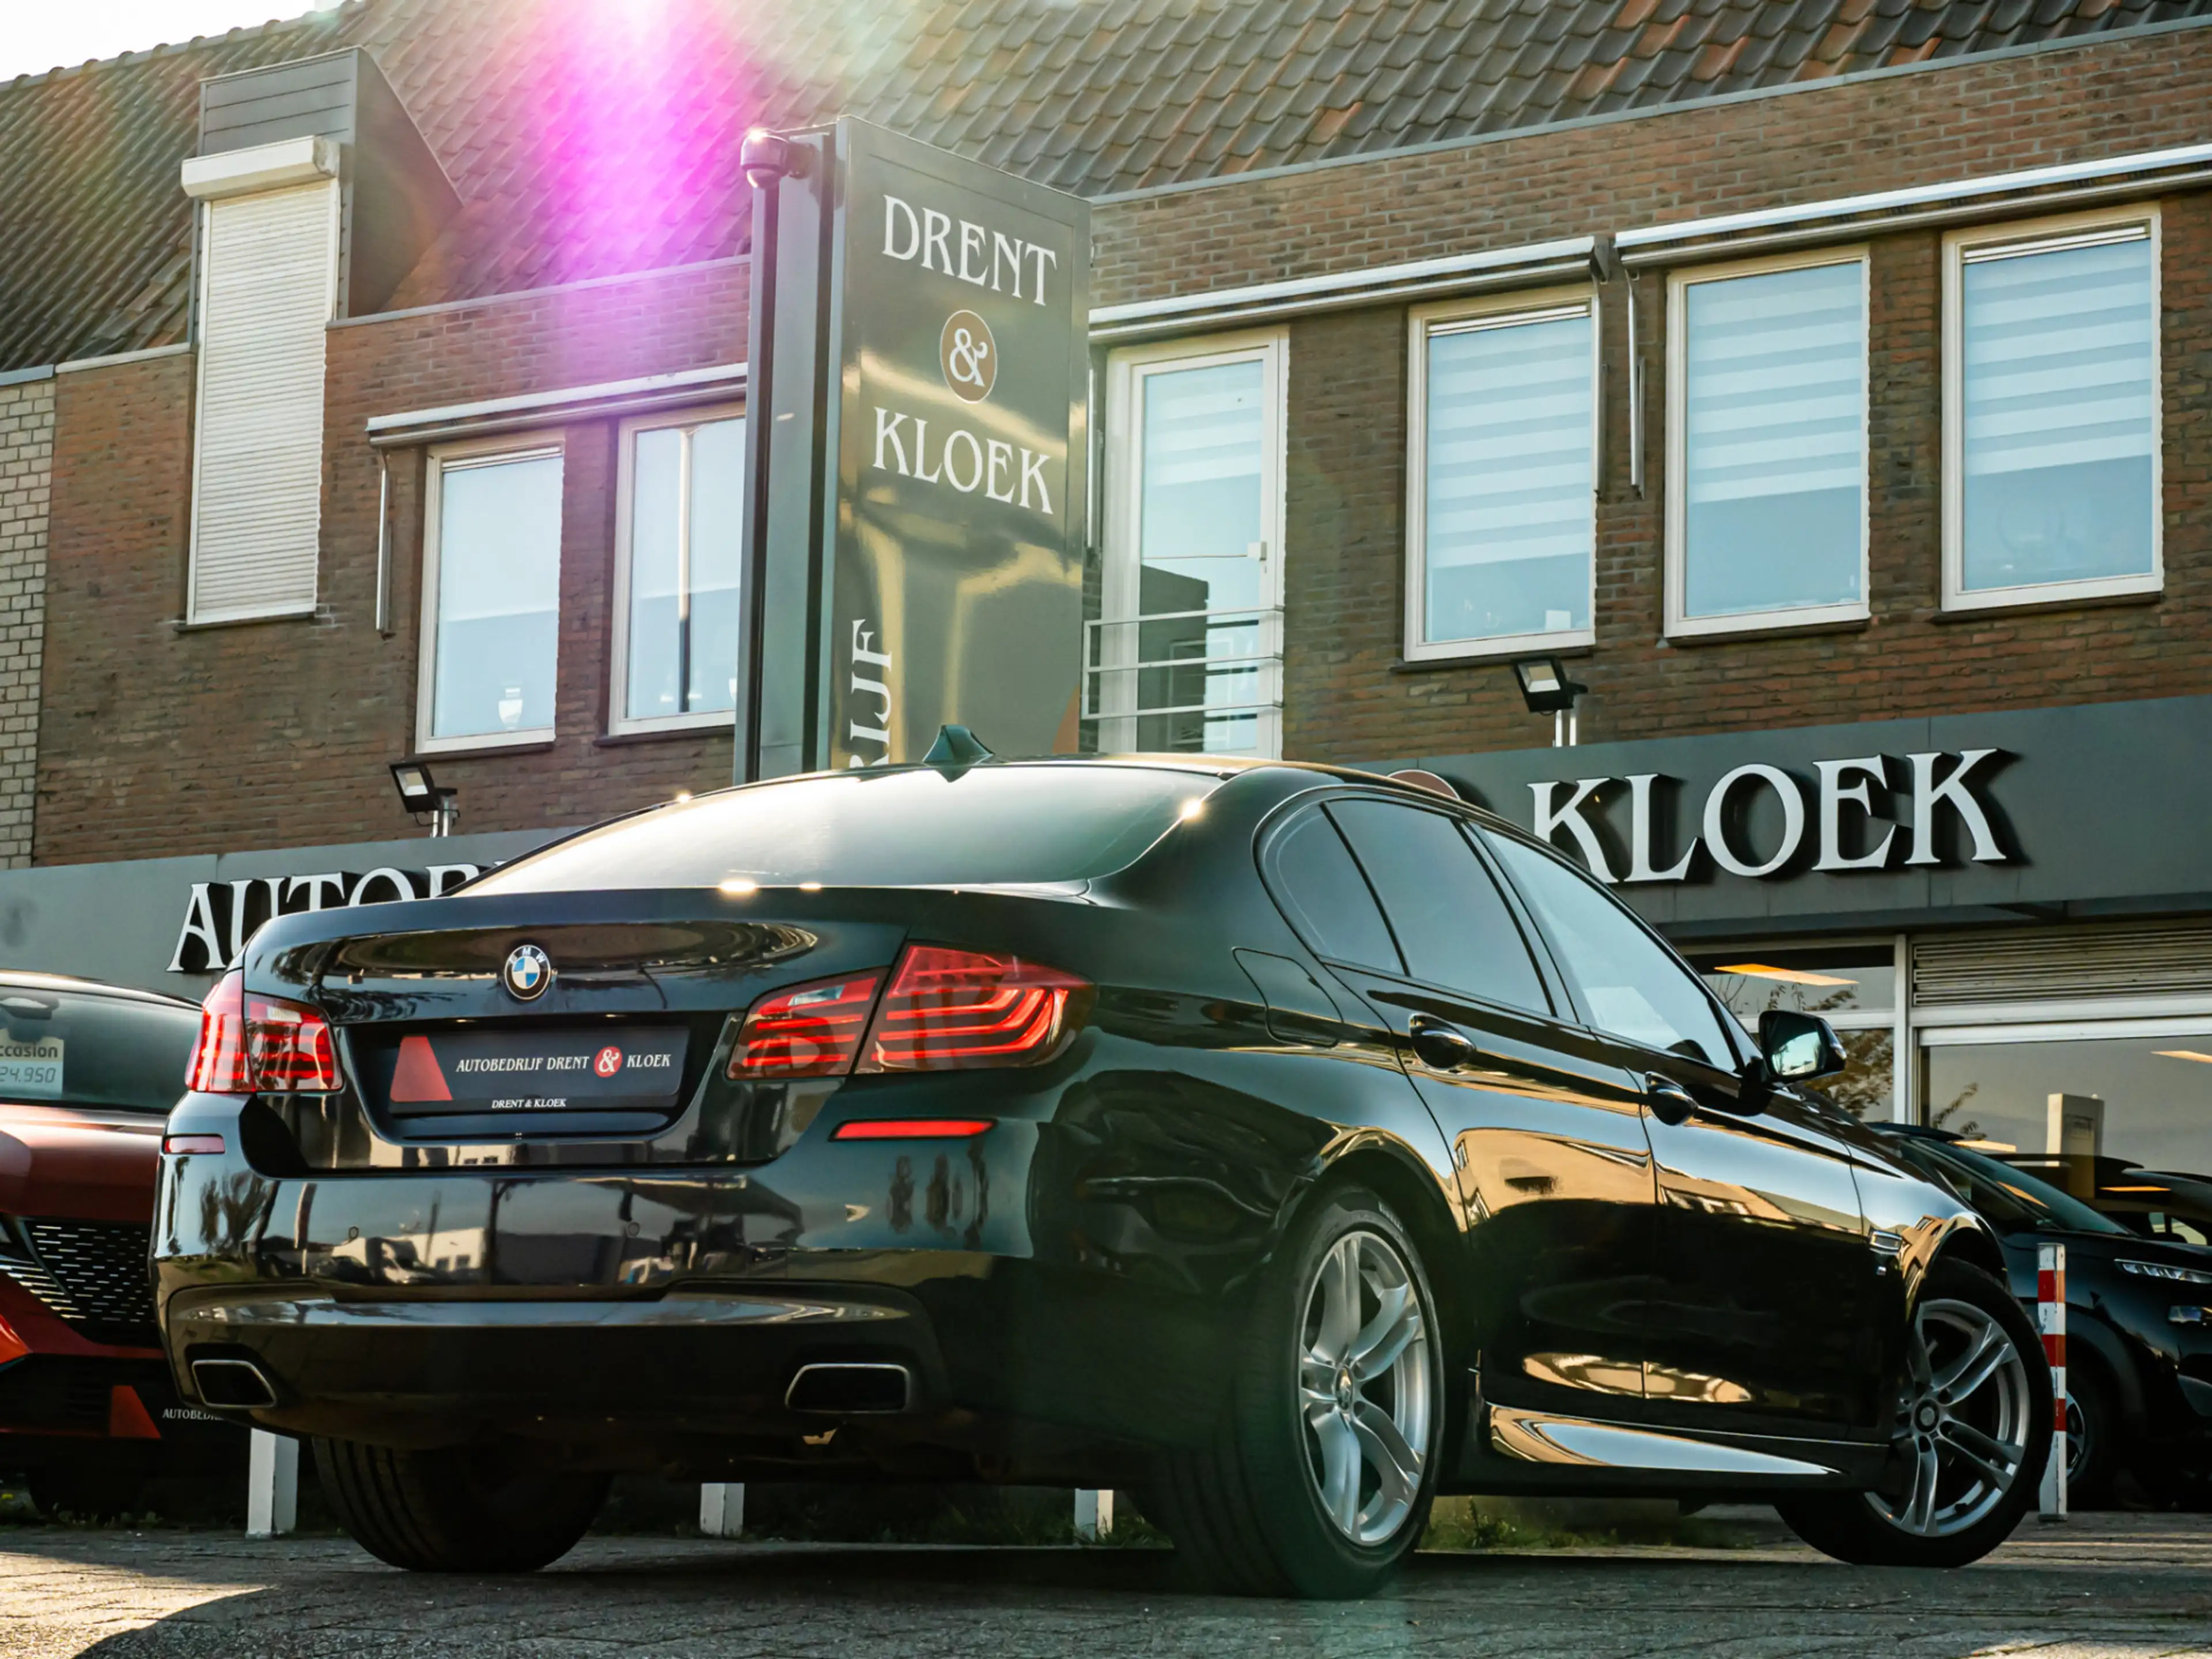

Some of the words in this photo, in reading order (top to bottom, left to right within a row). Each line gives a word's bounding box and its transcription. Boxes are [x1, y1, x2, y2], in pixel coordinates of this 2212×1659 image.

[882, 195, 1057, 306] DRENT
[949, 328, 988, 387] &
[873, 407, 1054, 514] KLOEK
[850, 619, 892, 768] IJF
[1527, 748, 2006, 883] KLOEK
[456, 1057, 544, 1073] AUTOBEDRIJF
[546, 1056, 590, 1070] DRENT
[598, 1049, 619, 1073] &
[626, 1054, 671, 1068] KLOEK
[491, 1099, 524, 1109] DRENT
[525, 1099, 532, 1108] &
[533, 1099, 567, 1108] KLOEK
